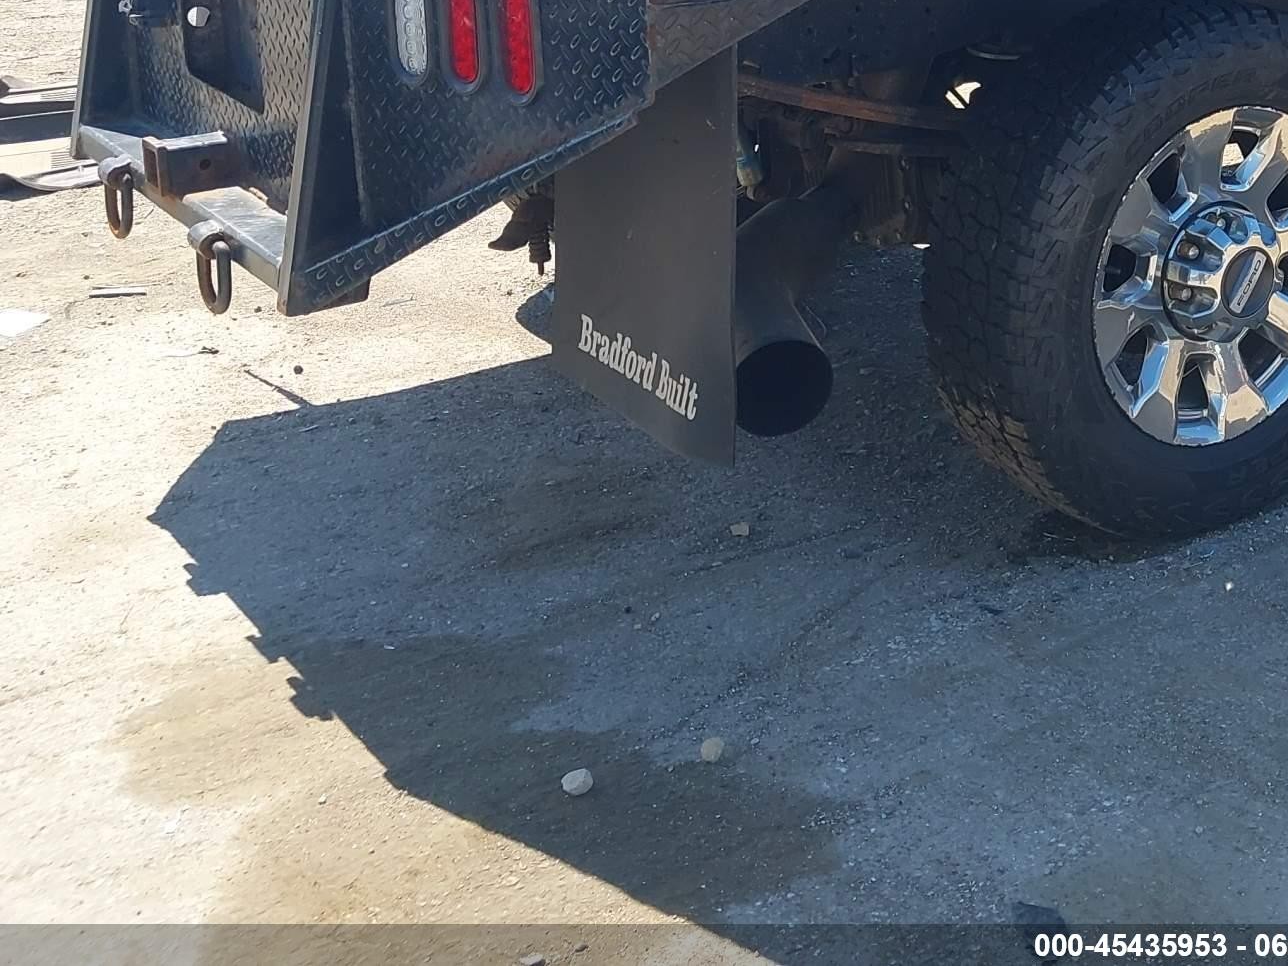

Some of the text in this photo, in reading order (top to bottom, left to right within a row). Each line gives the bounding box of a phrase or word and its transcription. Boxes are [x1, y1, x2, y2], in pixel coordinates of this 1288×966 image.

[1236, 259, 1262, 307] FORD
[578, 313, 699, 421] Bradford Built
